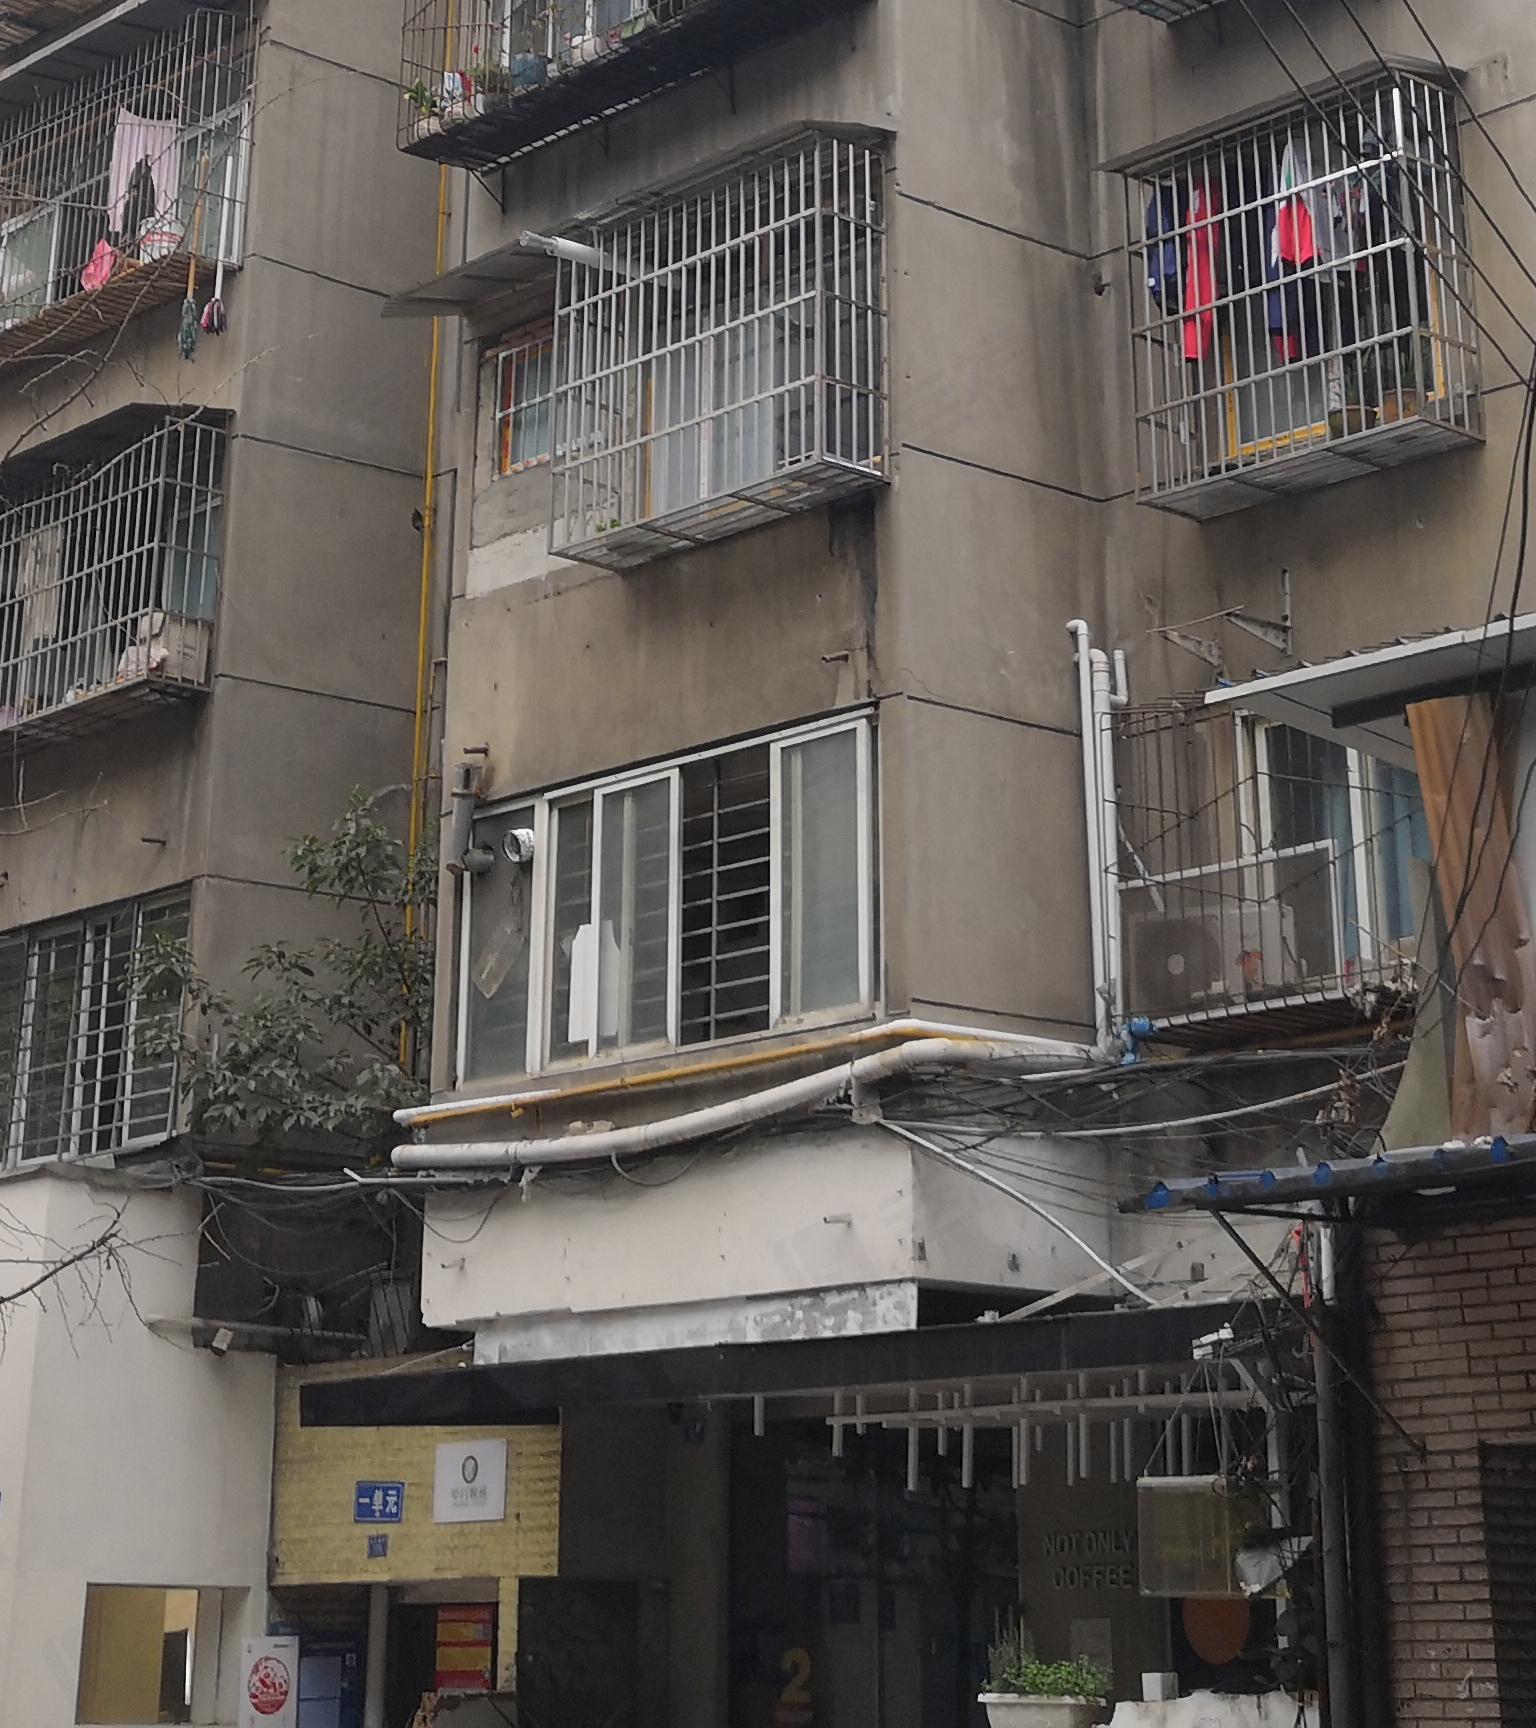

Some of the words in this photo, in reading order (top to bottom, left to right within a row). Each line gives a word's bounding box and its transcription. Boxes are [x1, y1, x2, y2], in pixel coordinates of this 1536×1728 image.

[358, 1488, 398, 1518] 一单元
[1044, 1533, 1080, 1556] NOT
[1085, 1530, 1133, 1553] ONLY
